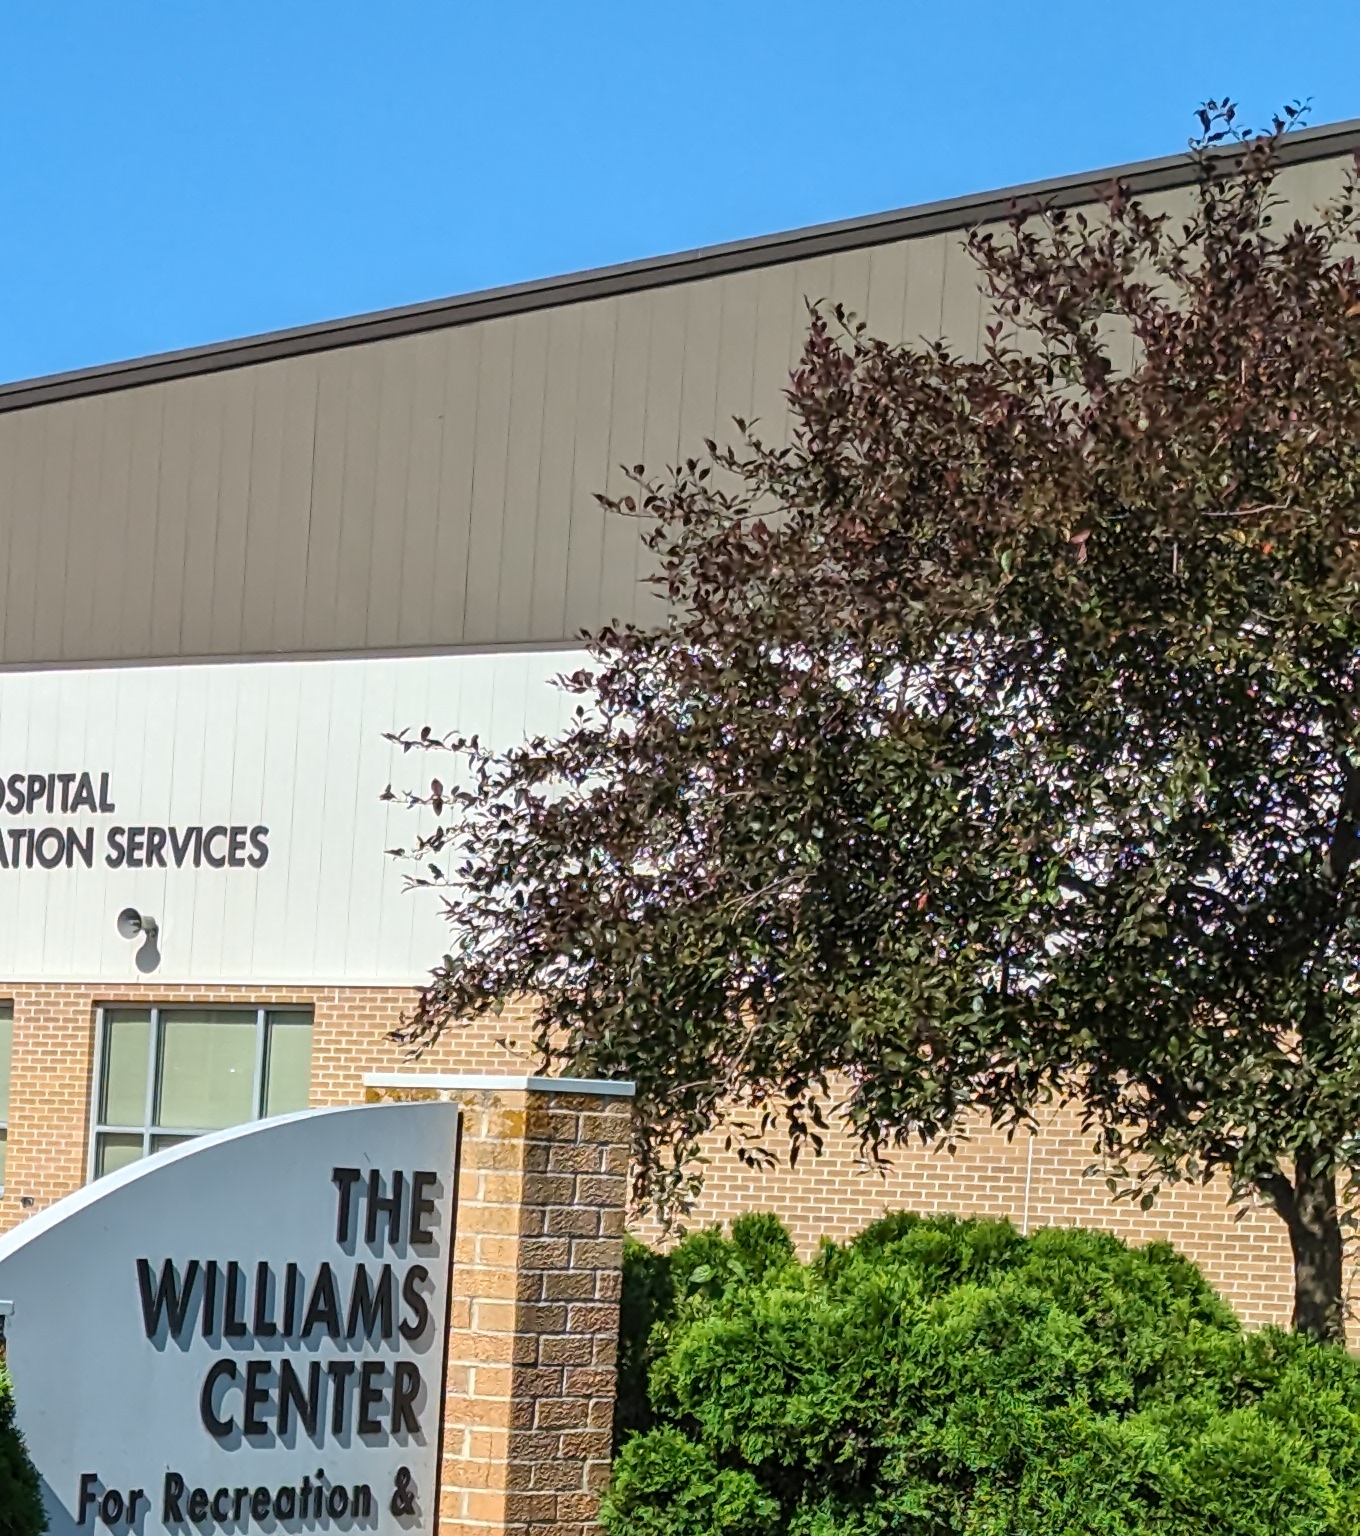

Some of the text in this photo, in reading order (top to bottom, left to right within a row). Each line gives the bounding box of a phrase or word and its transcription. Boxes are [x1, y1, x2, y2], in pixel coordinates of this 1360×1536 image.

[105, 826, 269, 868] SERVICES
[332, 1167, 437, 1245] THE
[137, 1259, 429, 1338] WILLIAMS
[200, 1359, 420, 1435] CENTER
[78, 1466, 415, 1525] For Recreation &
